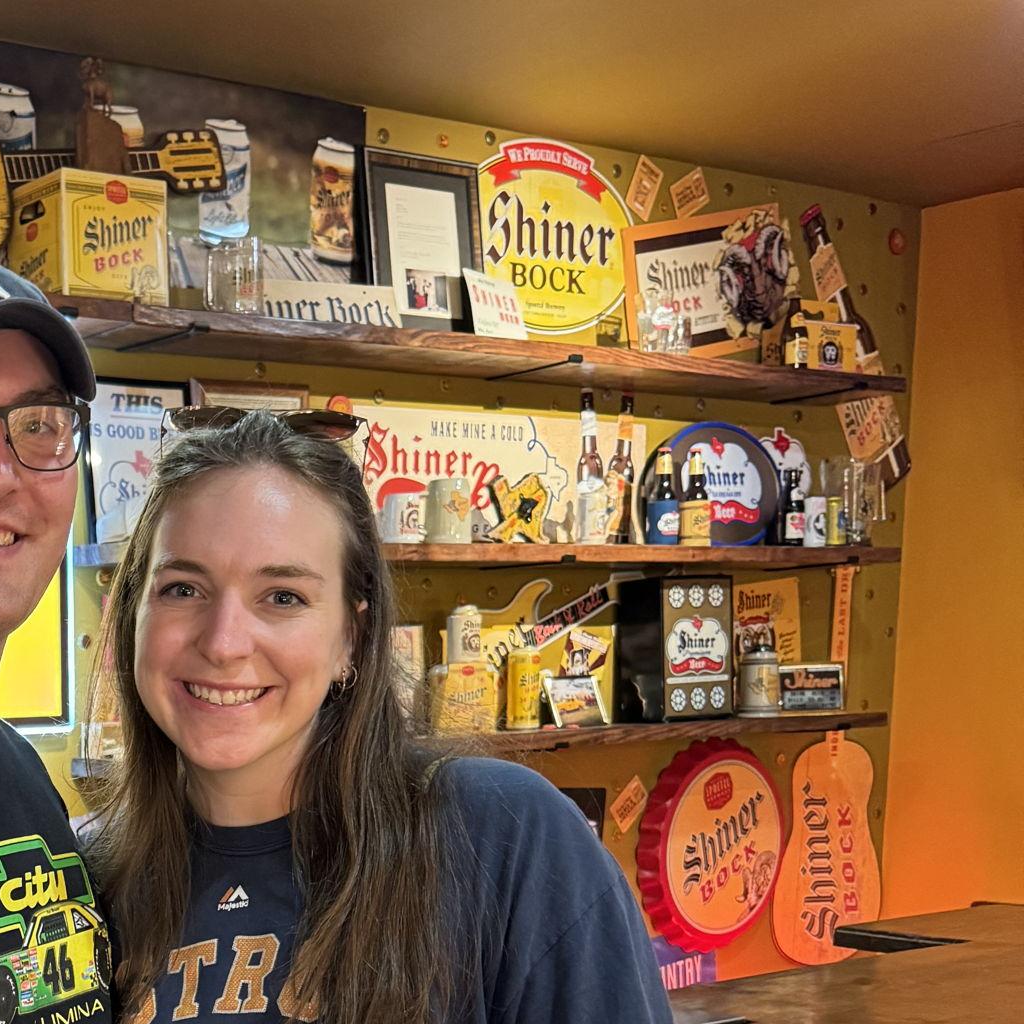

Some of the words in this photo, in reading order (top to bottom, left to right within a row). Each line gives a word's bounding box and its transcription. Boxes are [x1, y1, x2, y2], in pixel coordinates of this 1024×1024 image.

[508, 148, 522, 163] WE
[523, 147, 561, 164] PROUDLY
[562, 151, 589, 174] SERVE
[82, 215, 153, 256] Shiner
[486, 190, 615, 266] Shiner
[94, 249, 144, 272] BOCK
[646, 257, 710, 296] Shiner
[510, 261, 586, 295] BOCK
[264, 294, 321, 321] iner
[325, 296, 401, 327] Bock
[664, 296, 703, 314] OCK
[110, 393, 164, 415] THIS
[107, 424, 145, 440] GOOD
[430, 421, 458, 438] MAKE
[462, 423, 487, 440] MINE
[491, 426, 497, 441] A
[500, 425, 524, 442] COLD
[364, 421, 473, 485] Shiner
[737, 590, 772, 614] Shiner
[678, 630, 716, 654] Shiner
[683, 790, 764, 896] Shiner
[837, 804, 858, 914] BOCK
[699, 840, 758, 904] BOCK
[801, 780, 839, 940] Shiner
[217, 899, 250, 912] Majestic
[43, 941, 76, 997] 46
